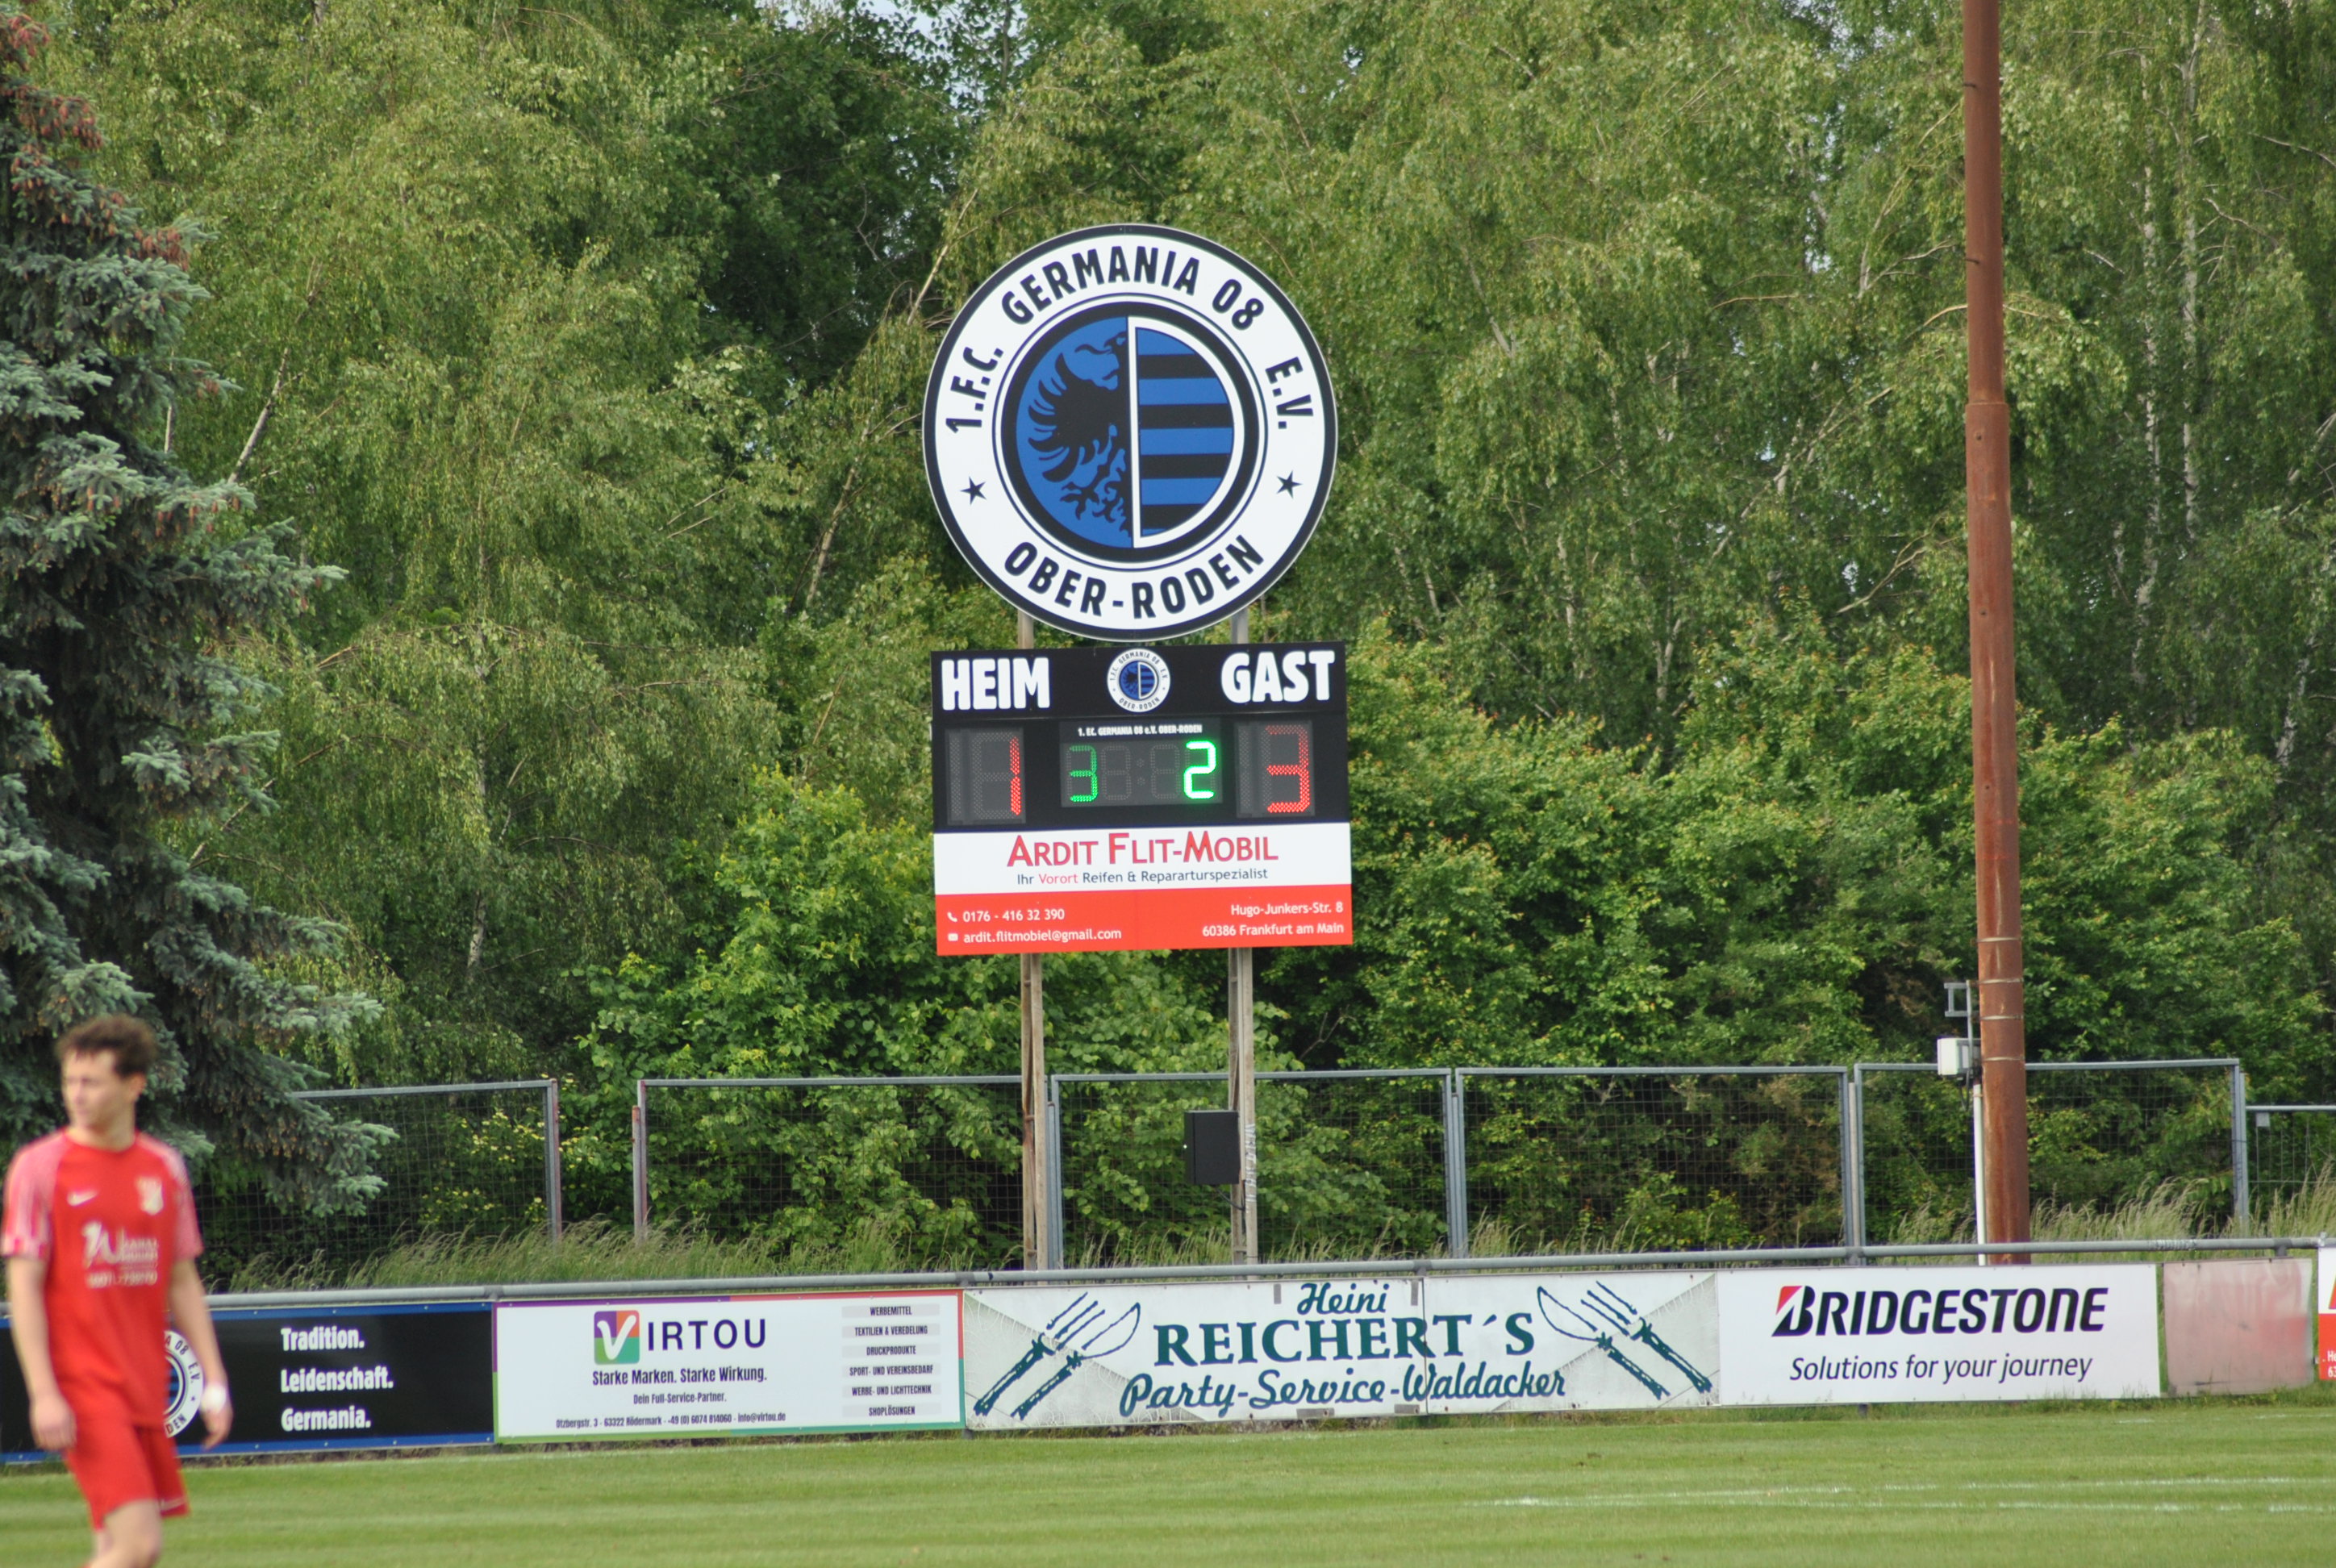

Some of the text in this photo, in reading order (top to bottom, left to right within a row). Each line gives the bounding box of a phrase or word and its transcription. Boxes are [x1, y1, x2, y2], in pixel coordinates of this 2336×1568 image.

[945, 245, 1314, 434] 1.F.C. GERMANIA 08 E.V.
[1003, 535, 1265, 619] OBER-RODEN
[1118, 651, 1150, 664] GERMANIA
[941, 657, 1051, 711] HEIM
[1220, 650, 1336, 703] GAST
[1078, 728, 1086, 736] 1.
[1098, 726, 1133, 736] GERMANIA
[1133, 725, 1144, 735] 08
[1158, 724, 1203, 734] OBER-RODEN
[1010, 736, 1022, 815] 1
[1069, 744, 1099, 802] 3
[1183, 740, 1216, 799] 2
[1265, 726, 1312, 814] 3
[1017, 874, 1035, 885] Ihr
[1038, 873, 1078, 885] Vorort
[1082, 871, 1124, 883] Reifen
[1127, 871, 1137, 882] &
[962, 911, 991, 922] 0176
[1002, 910, 1024, 921] 416
[1027, 909, 1041, 921] 32
[1044, 908, 1066, 920] 390
[1230, 902, 1344, 918] Hugo-Junkers-Str. 8
[963, 928, 1122, 943] ardit.flitmobiel@gmail.com
[1202, 923, 1344, 936] 60386 Frankfurt am Main
[1296, 1282, 1390, 1315] Heini
[870, 1306, 912, 1316] WERBEMITTEL
[1771, 1285, 2109, 1337] BRIDGESTONE
[281, 1325, 365, 1351] Tradition.
[854, 1327, 883, 1336] TEXTILIEN
[891, 1325, 928, 1335] VEREDELUNG
[866, 1345, 916, 1356] DRUCKPRODUKTE
[593, 1366, 767, 1386] Starke Marken. Starke Wirkung.
[849, 1365, 933, 1376] SPORT- UND VEREINSBEDARF
[1789, 1353, 2094, 1384] Solutions for your journey
[281, 1366, 394, 1393] Leidenschaft.
[1120, 1361, 1566, 1418] Party-Service-Waldacker
[633, 1392, 727, 1404] Dein Full-Service-Partner.
[852, 1385, 932, 1396] WERBE- UND LICHTTECHNIK
[281, 1405, 371, 1432] Germania.
[603, 1417, 624, 1427] 63322
[626, 1416, 662, 1426] Rödermark
[680, 1415, 690, 1424] (0)
[690, 1415, 707, 1424] 6074
[708, 1414, 732, 1424] 814060
[737, 1412, 786, 1423] info@virtou.de
[869, 1405, 916, 1416] SHOPLÖSUNGEN
